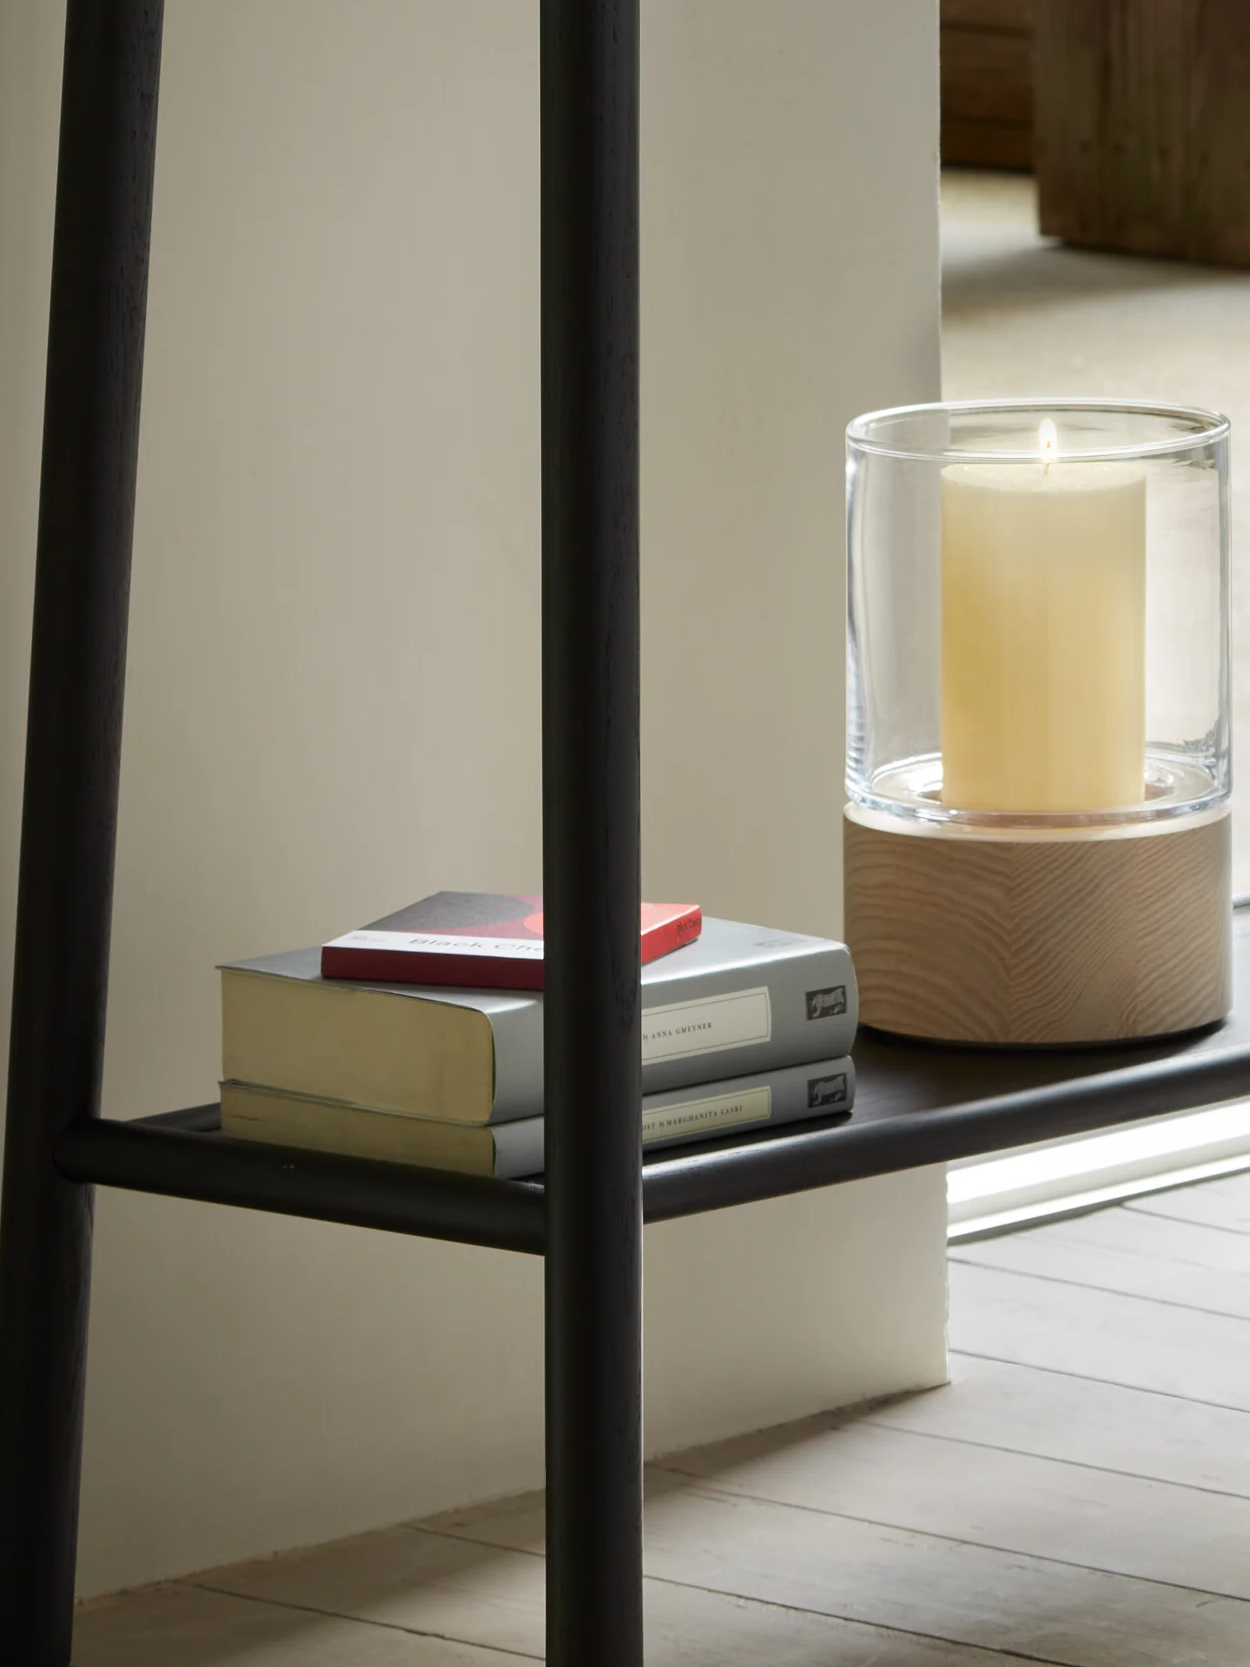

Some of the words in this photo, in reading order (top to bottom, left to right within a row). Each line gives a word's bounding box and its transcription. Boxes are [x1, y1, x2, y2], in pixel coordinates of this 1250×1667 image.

[409, 938, 484, 948] Black
[494, 943, 543, 951] Che
[651, 1029, 673, 1040] ANNA
[675, 1021, 713, 1035] GMEYNER
[666, 1110, 718, 1126] MARGHANITA
[720, 1104, 743, 1116] LASKI
